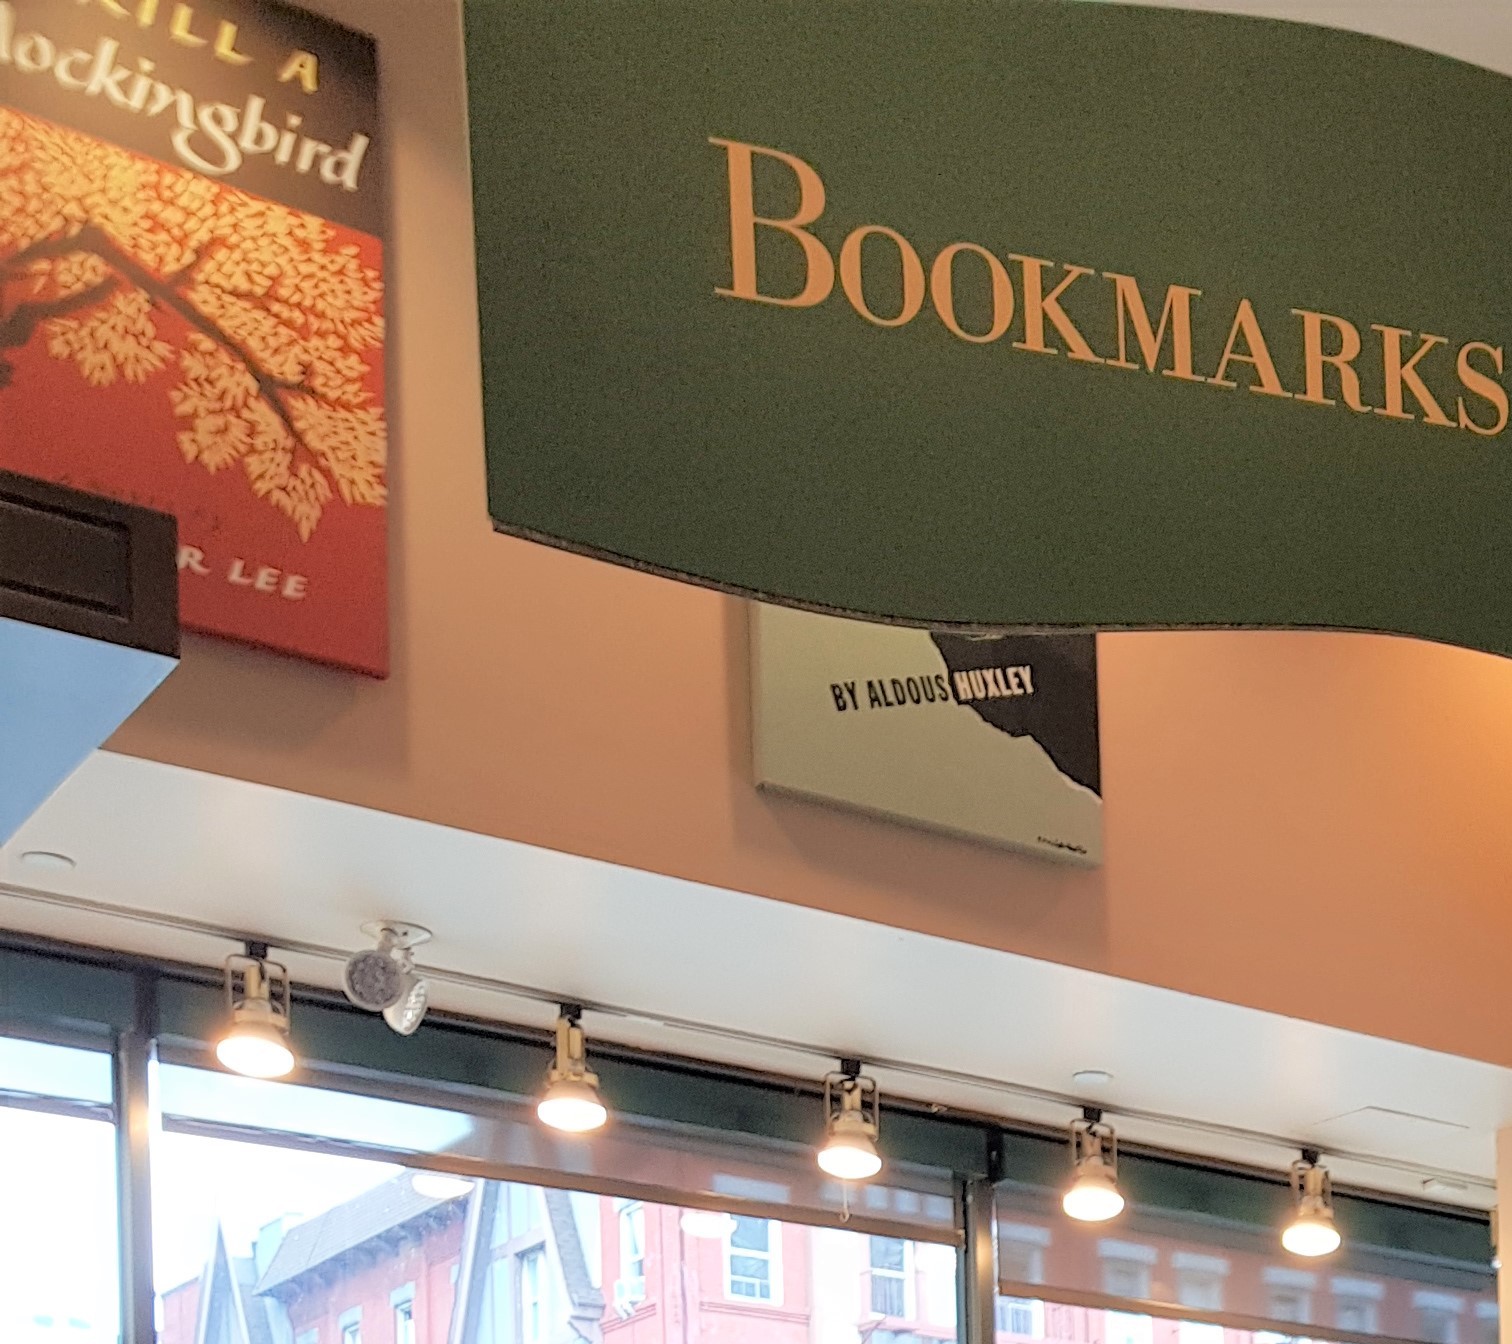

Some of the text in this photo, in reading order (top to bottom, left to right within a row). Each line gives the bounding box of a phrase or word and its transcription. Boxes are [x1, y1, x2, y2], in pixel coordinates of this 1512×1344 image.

[78, 0, 320, 94] ILL A
[707, 136, 1510, 435] BOOKMARKS
[228, 556, 311, 600] LEE
[830, 663, 1035, 712] BY ALDOUS HUXLEY
